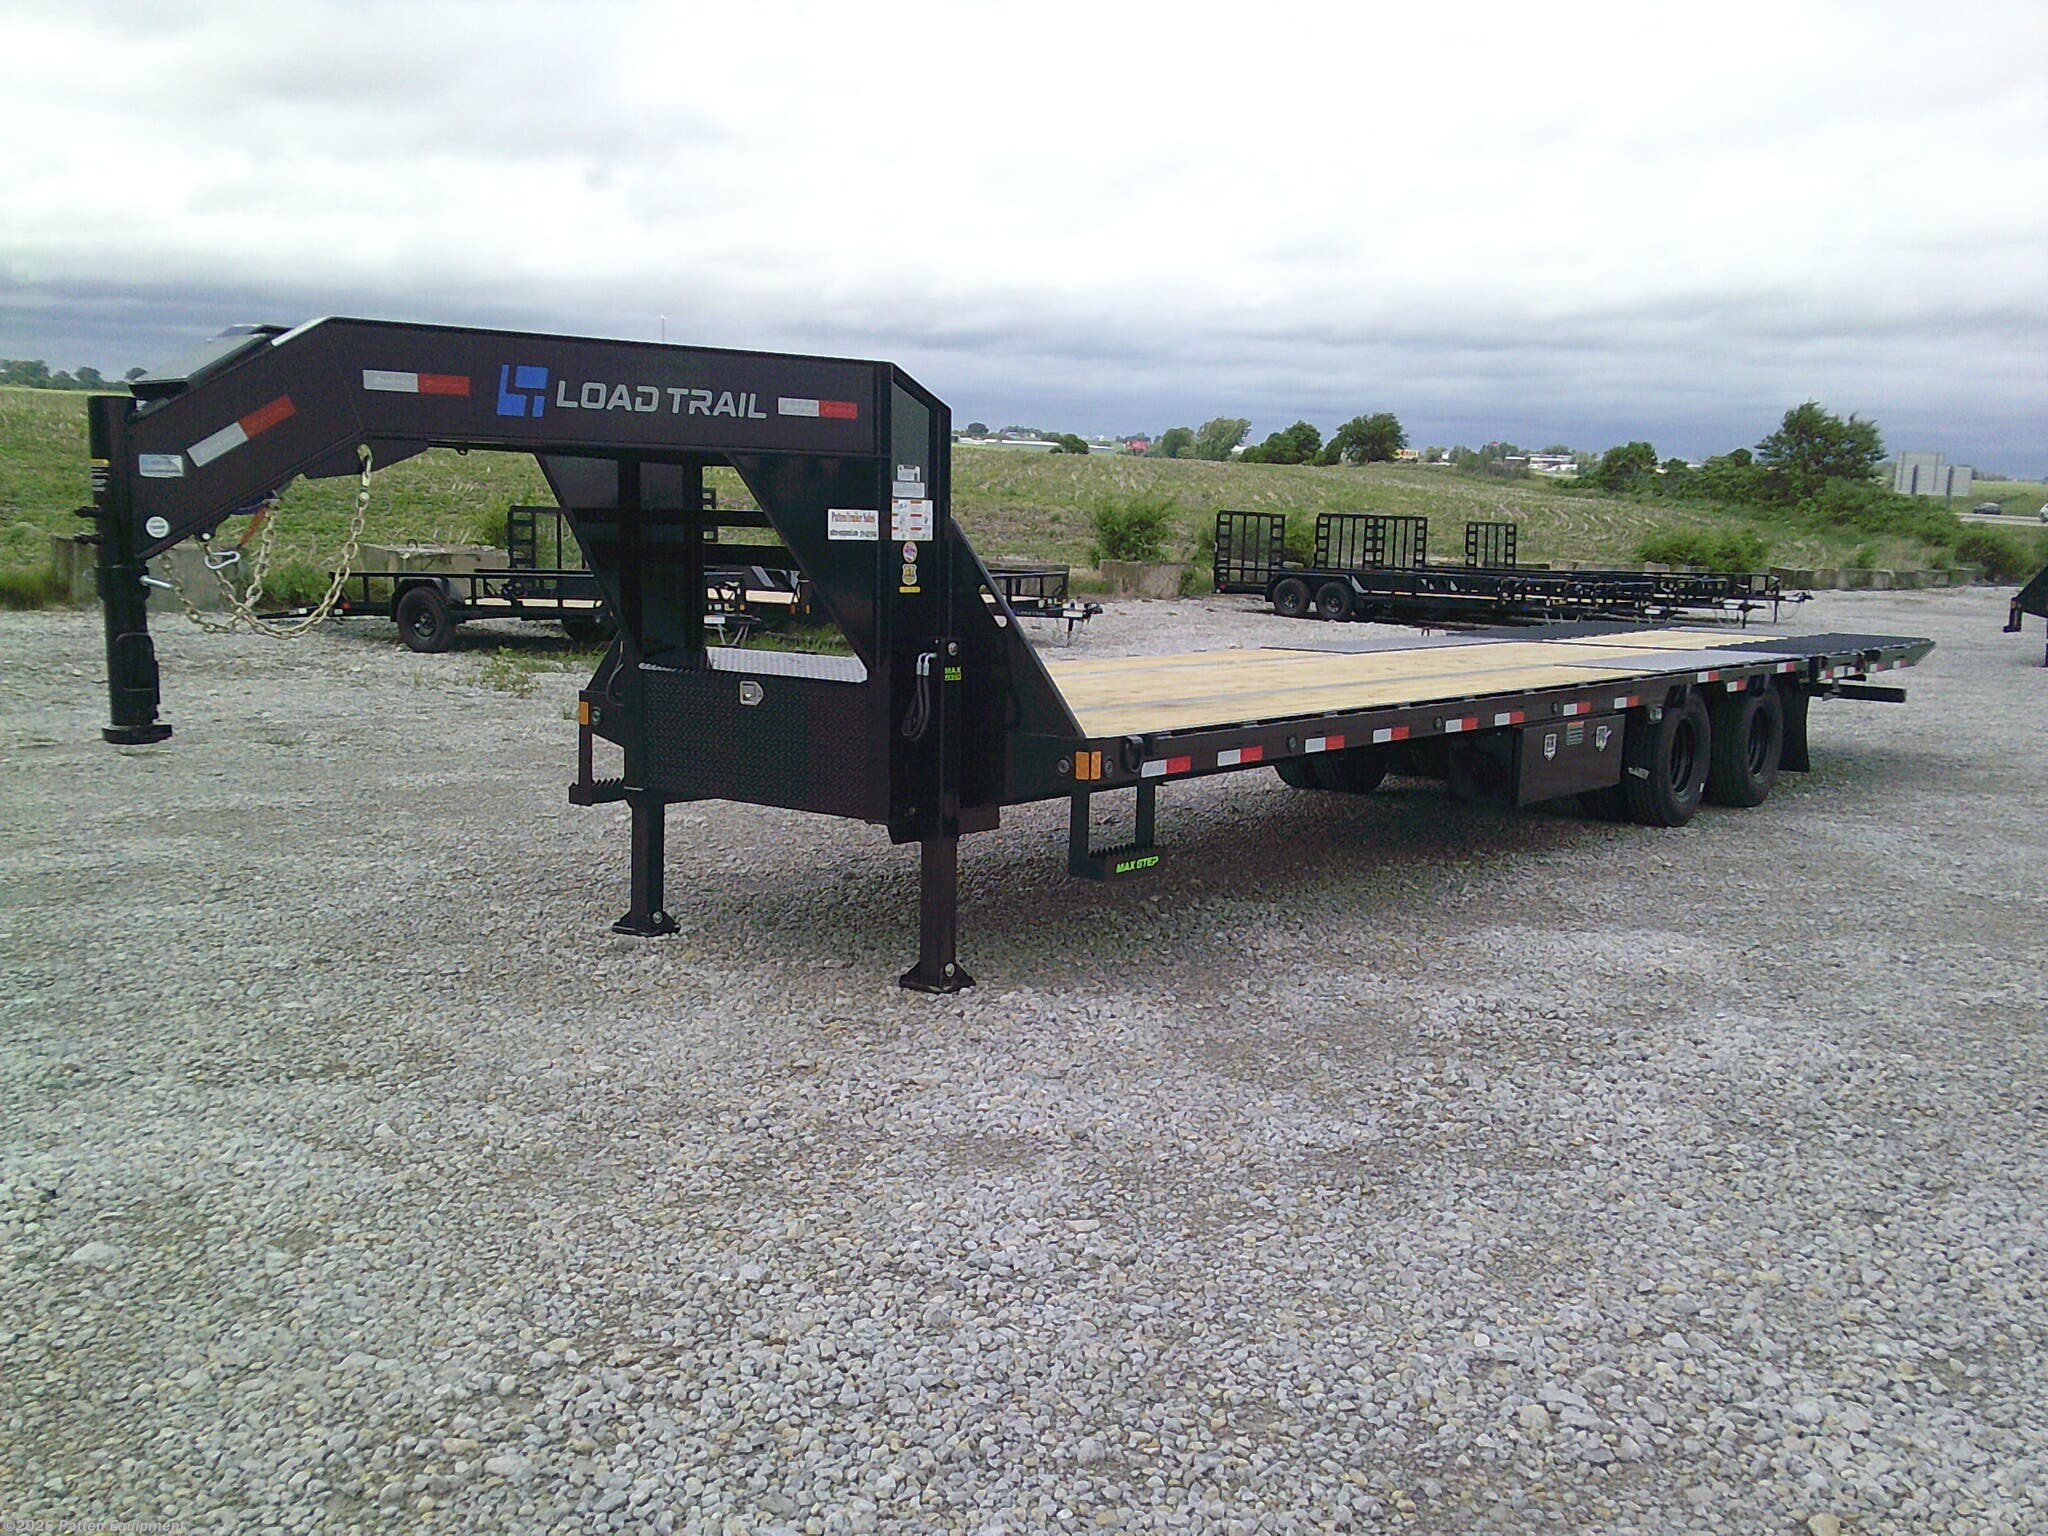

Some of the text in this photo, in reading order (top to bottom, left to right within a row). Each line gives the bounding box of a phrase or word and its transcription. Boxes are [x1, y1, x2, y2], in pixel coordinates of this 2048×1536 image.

[556, 380, 768, 419] LOAD TRAIL
[944, 666, 962, 674] MAX
[1115, 855, 1160, 874] MAX STEP
